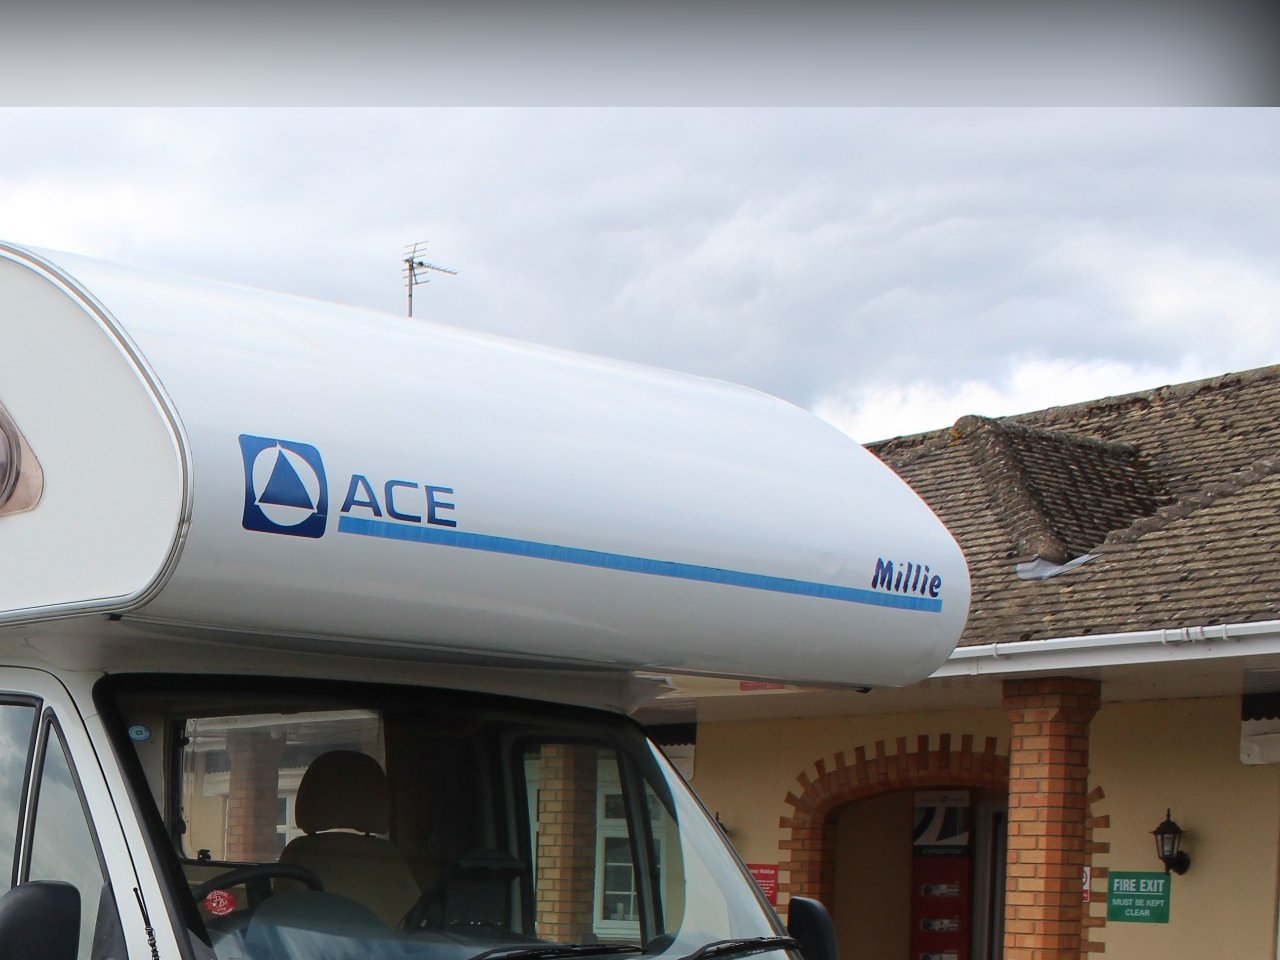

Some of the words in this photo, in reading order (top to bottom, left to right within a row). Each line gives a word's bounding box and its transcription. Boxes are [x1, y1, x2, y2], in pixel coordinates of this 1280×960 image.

[340, 474, 458, 528] ACE
[871, 557, 942, 598] Millie
[1113, 878, 1137, 892] FIRE
[1140, 879, 1165, 892] EXIT
[1112, 898, 1133, 906] MUST
[1146, 899, 1165, 907] KEPT
[1125, 908, 1150, 917] CLEAR
